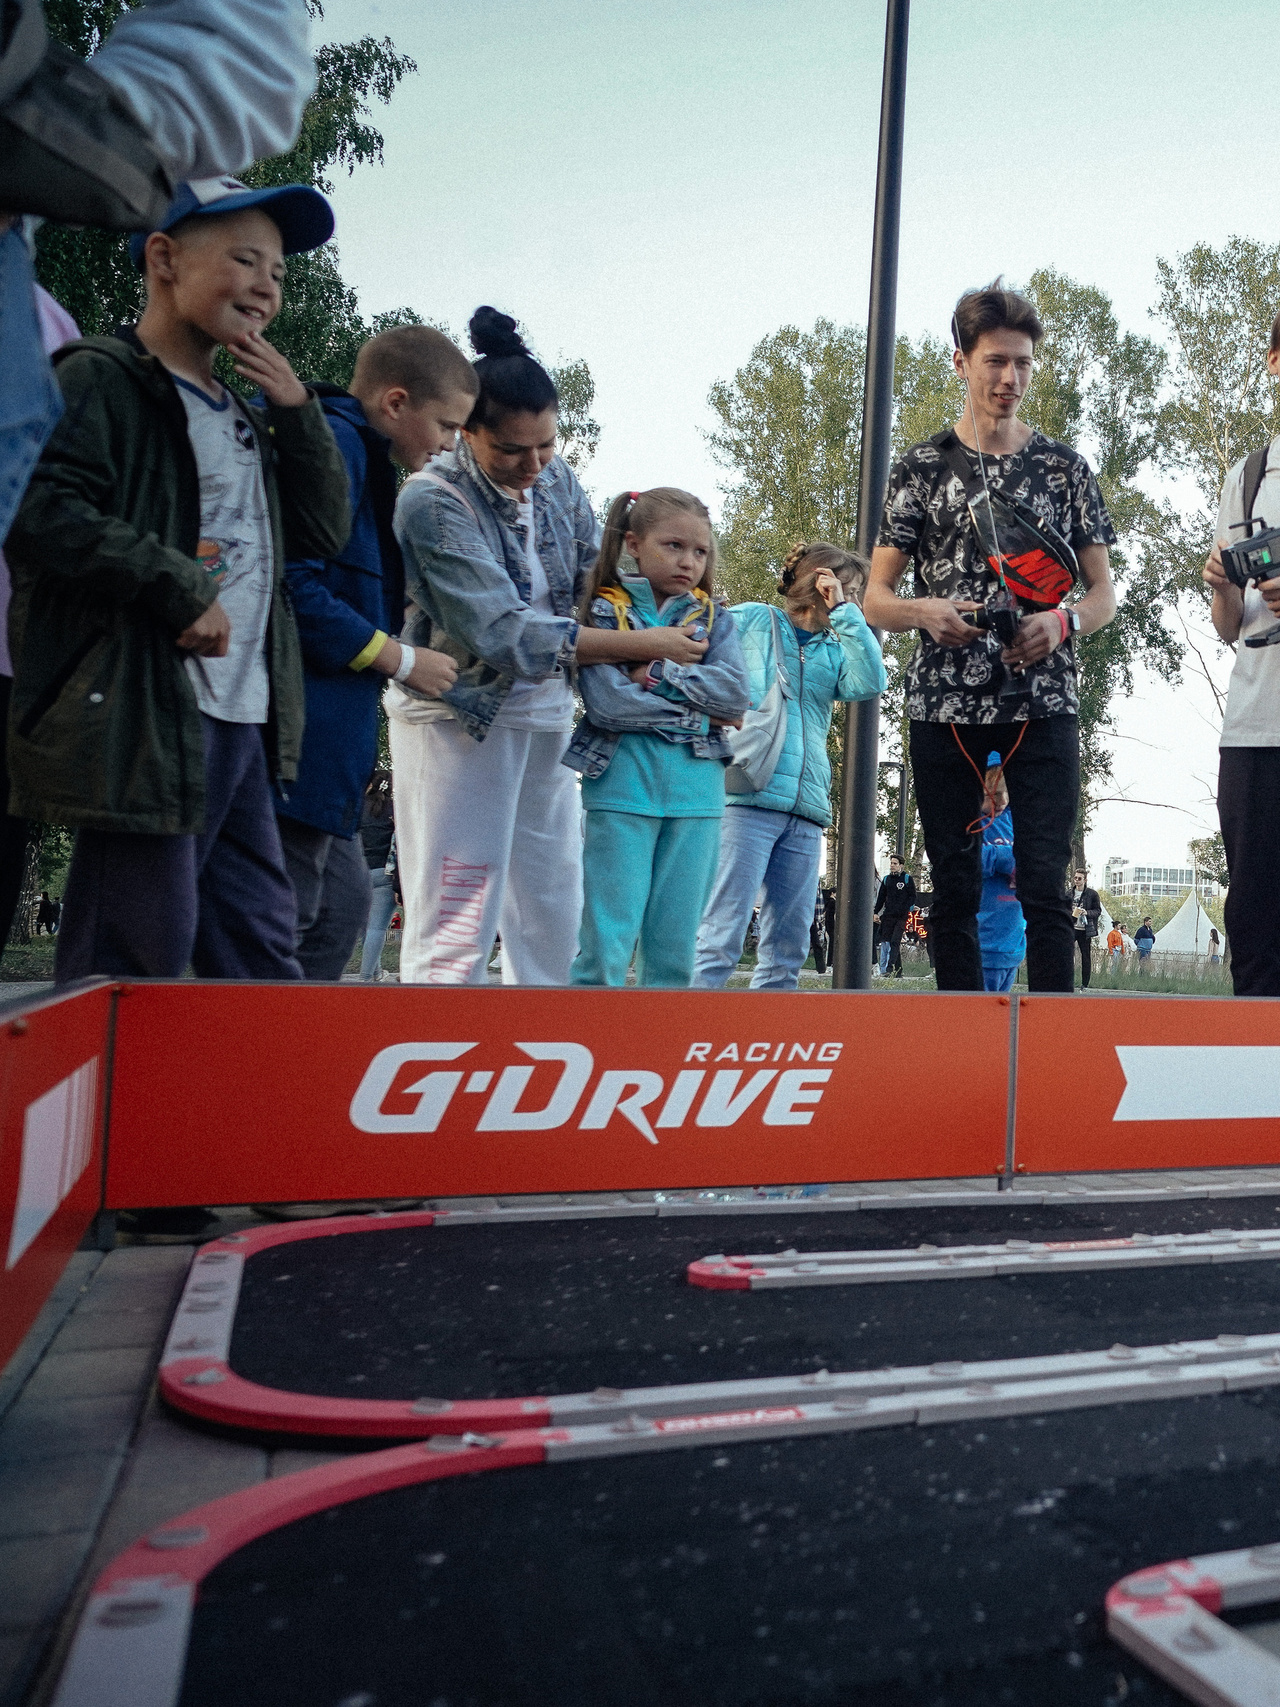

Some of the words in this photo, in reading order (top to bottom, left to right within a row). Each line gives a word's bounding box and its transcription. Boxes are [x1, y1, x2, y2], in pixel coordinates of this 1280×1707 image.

[1006, 548, 1075, 599] NIKE
[436, 855, 489, 948] VOLLEY
[684, 1041, 845, 1063] RACING
